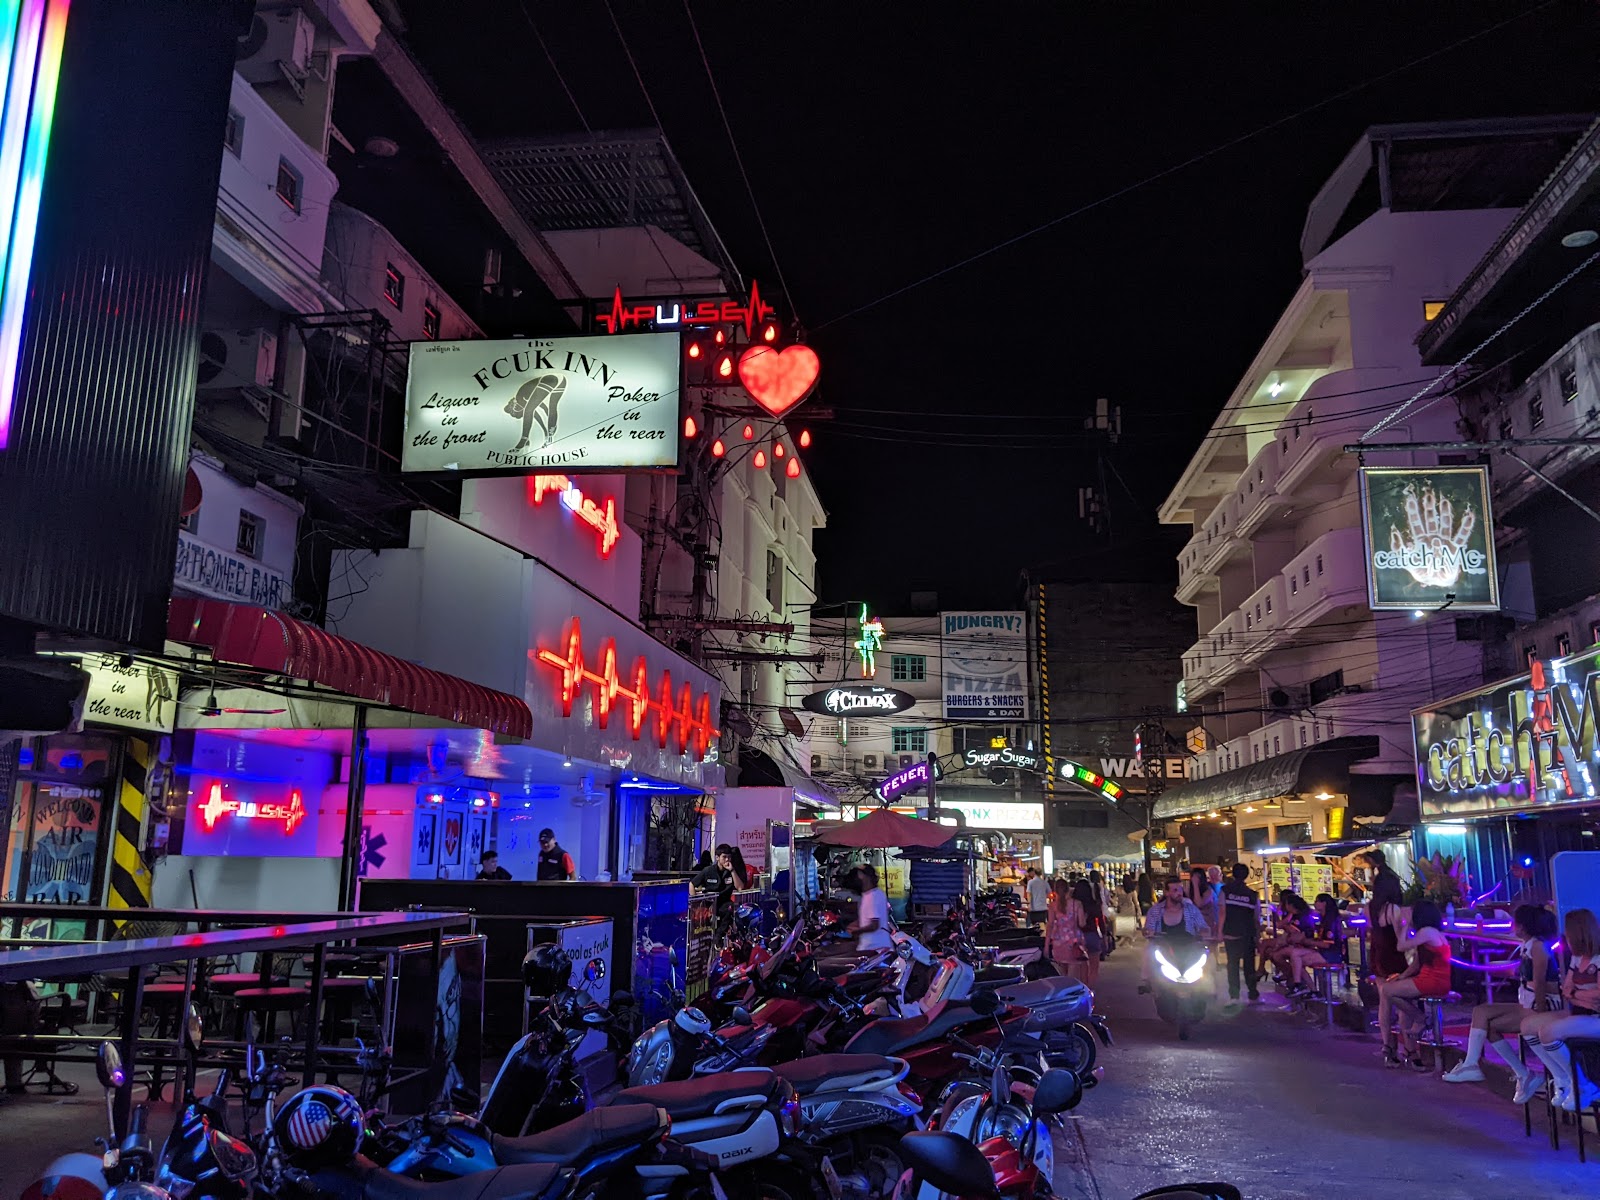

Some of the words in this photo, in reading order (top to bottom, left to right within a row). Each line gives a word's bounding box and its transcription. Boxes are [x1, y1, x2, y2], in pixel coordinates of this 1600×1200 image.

[634, 302, 743, 327] PULSE
[528, 340, 554, 348] the
[472, 349, 555, 391] FCUK
[562, 350, 618, 388] INN
[420, 392, 481, 413] Liquor
[607, 386, 660, 402] Poker
[441, 414, 458, 426] in
[623, 409, 641, 421] in
[412, 430, 438, 447] the
[442, 429, 487, 449] front
[596, 424, 622, 440] the
[629, 429, 666, 440] rear
[486, 450, 537, 466] PUBLIC
[541, 447, 589, 465] HOUSE
[945, 615, 1022, 635] HUNGRY?
[111, 681, 126, 694] in
[947, 671, 1023, 693] PIZZA
[89, 698, 110, 716] the
[114, 706, 142, 720] rear
[946, 694, 982, 706] BURGERS
[984, 696, 990, 706] &
[992, 695, 1024, 706] SNACKS
[966, 750, 1000, 766] Sugar
[1001, 748, 1036, 767] Sugar
[883, 766, 928, 796] FEVER
[36, 801, 96, 825] WELCOME
[44, 825, 84, 847] AIR
[29, 851, 92, 887] CONDITIONED
[583, 947, 592, 960] as
